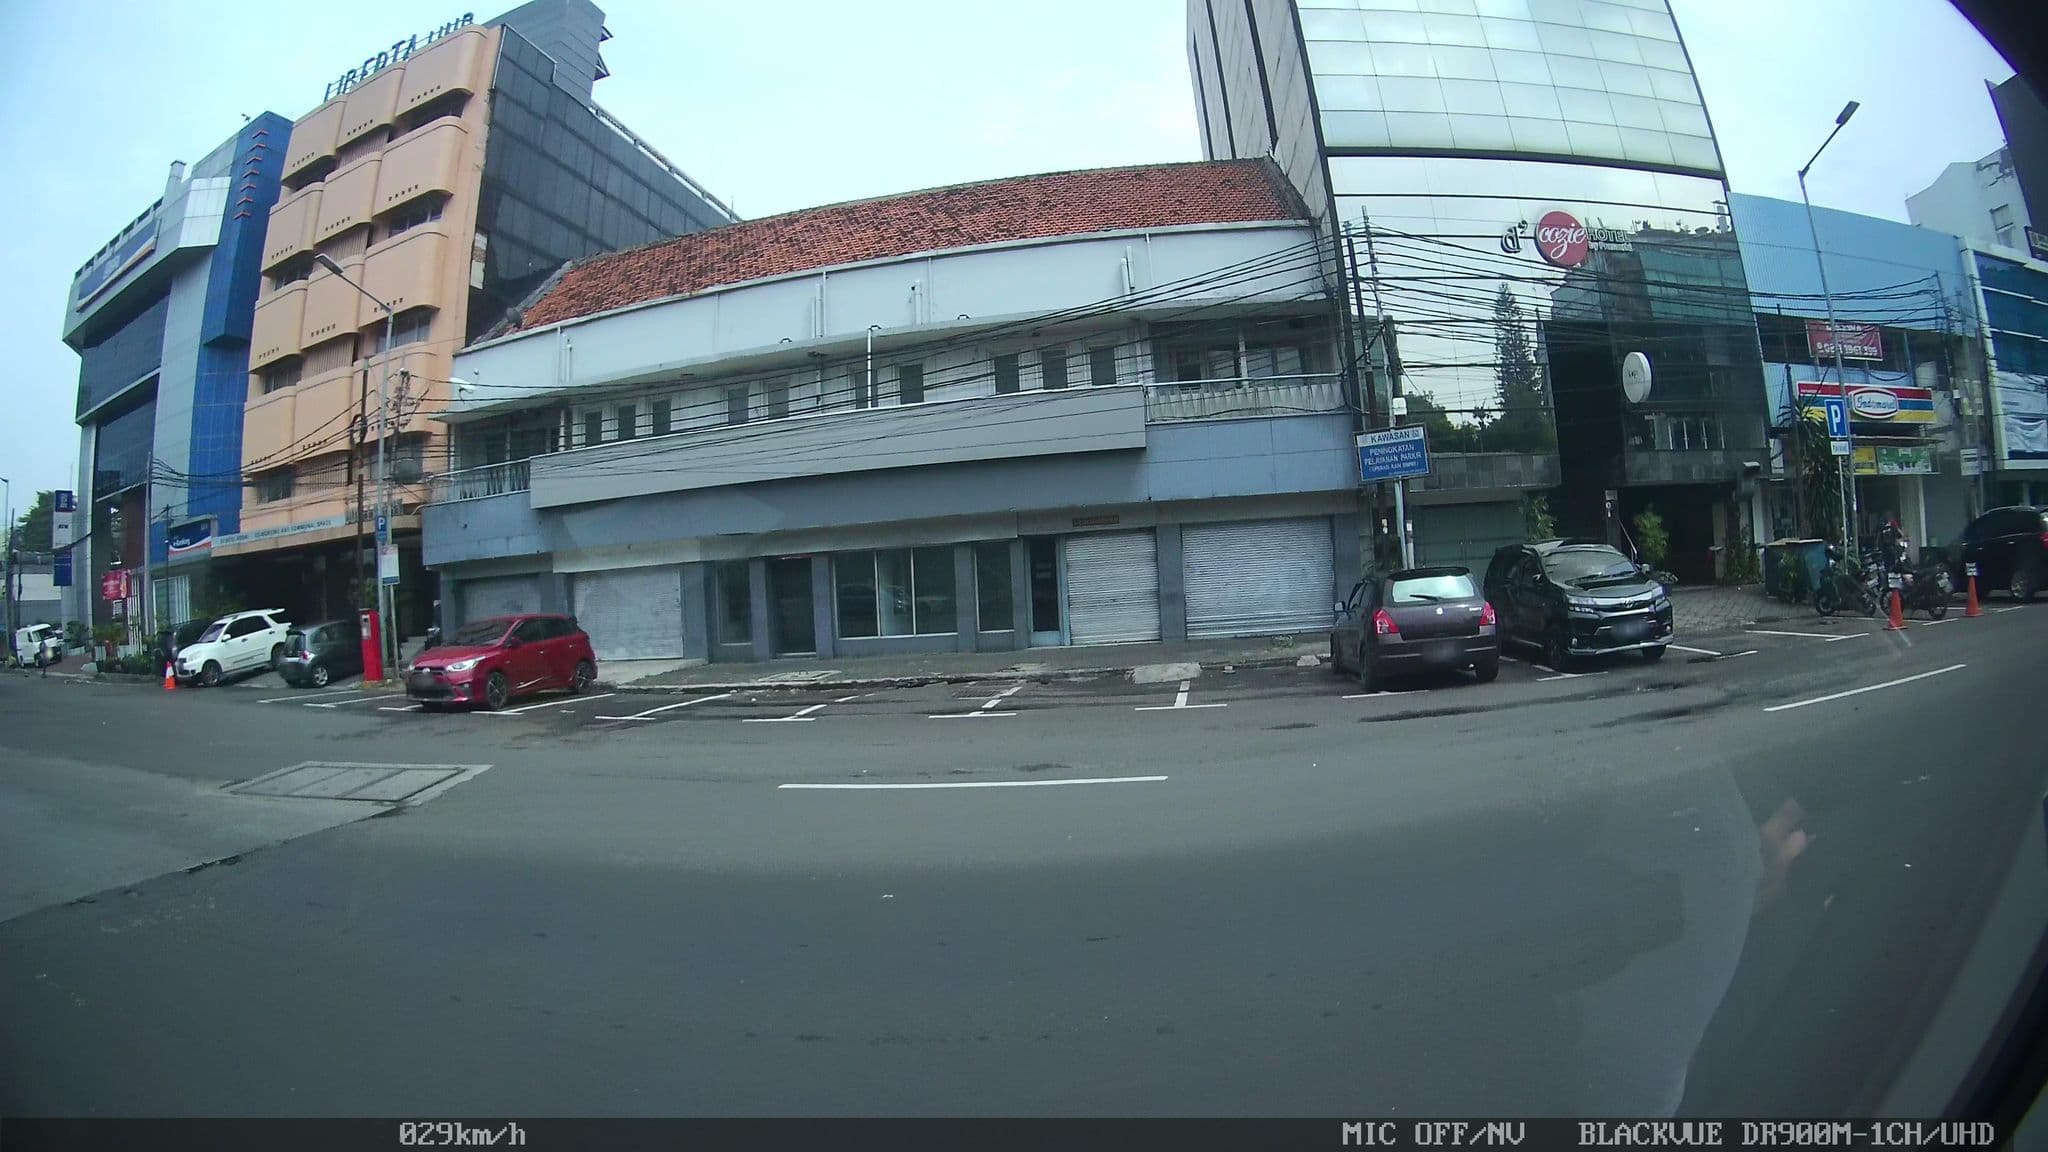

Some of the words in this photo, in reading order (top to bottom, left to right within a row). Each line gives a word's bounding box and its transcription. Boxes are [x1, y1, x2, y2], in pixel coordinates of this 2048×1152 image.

[1540, 223, 1588, 259] cozie
[1588, 229, 1629, 242] HOTEL
[1831, 404, 1841, 432] P
[1370, 430, 1410, 443] KAWASAN
[378, 517, 386, 530] P
